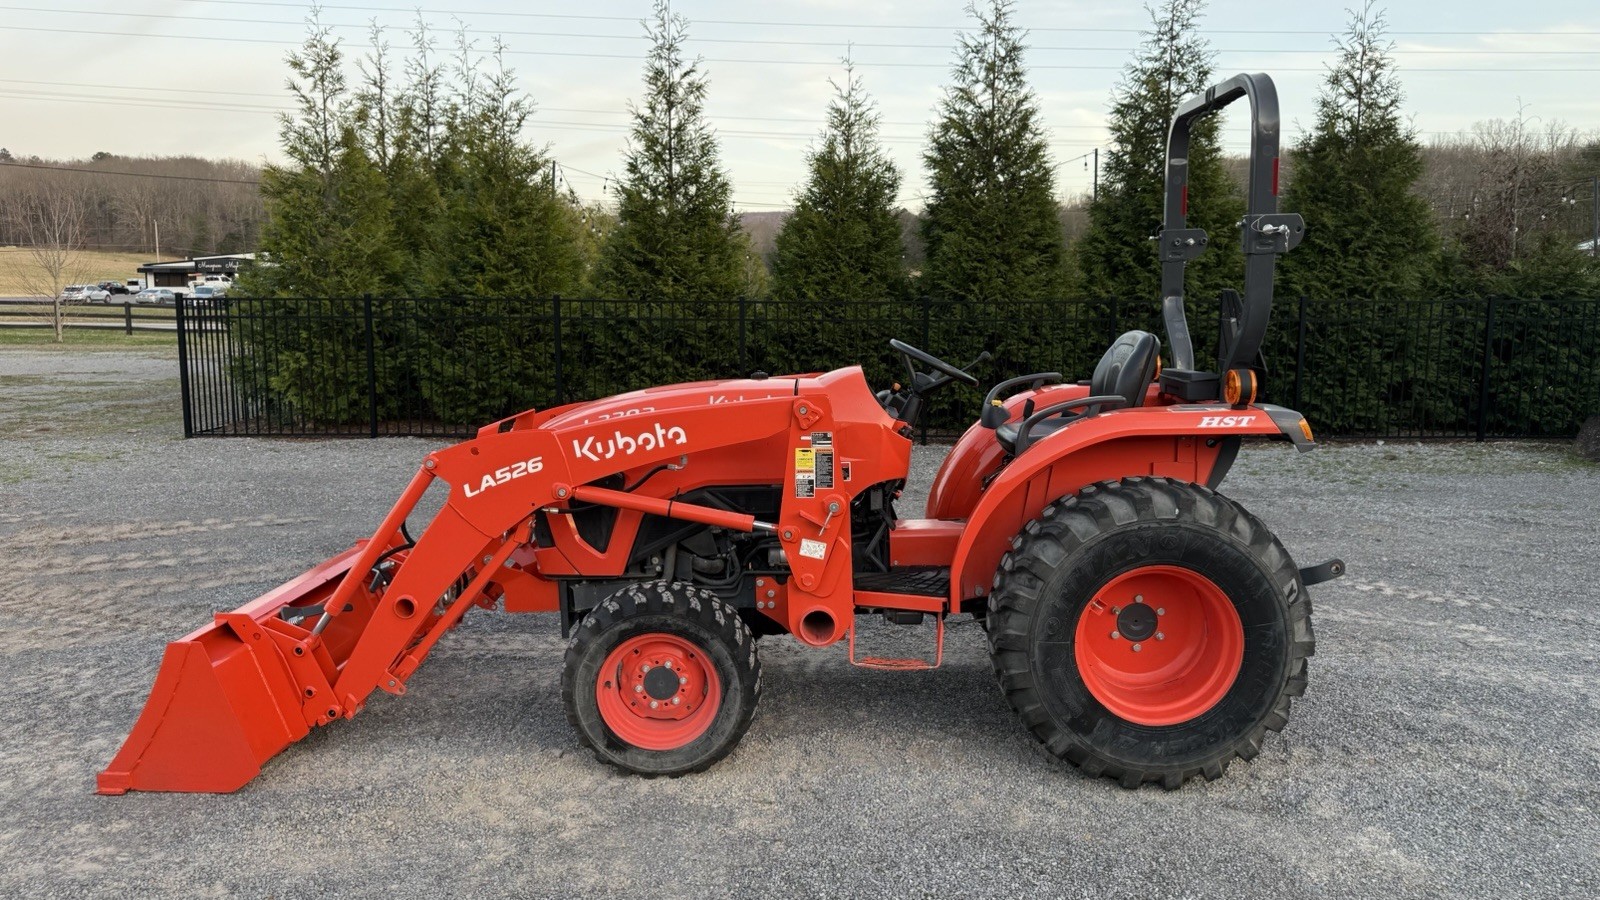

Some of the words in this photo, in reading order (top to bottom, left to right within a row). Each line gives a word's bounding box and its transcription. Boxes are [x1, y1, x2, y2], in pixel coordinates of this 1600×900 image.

[1197, 415, 1257, 428] HST
[572, 423, 687, 462] Kubota
[463, 456, 544, 498] LA526
